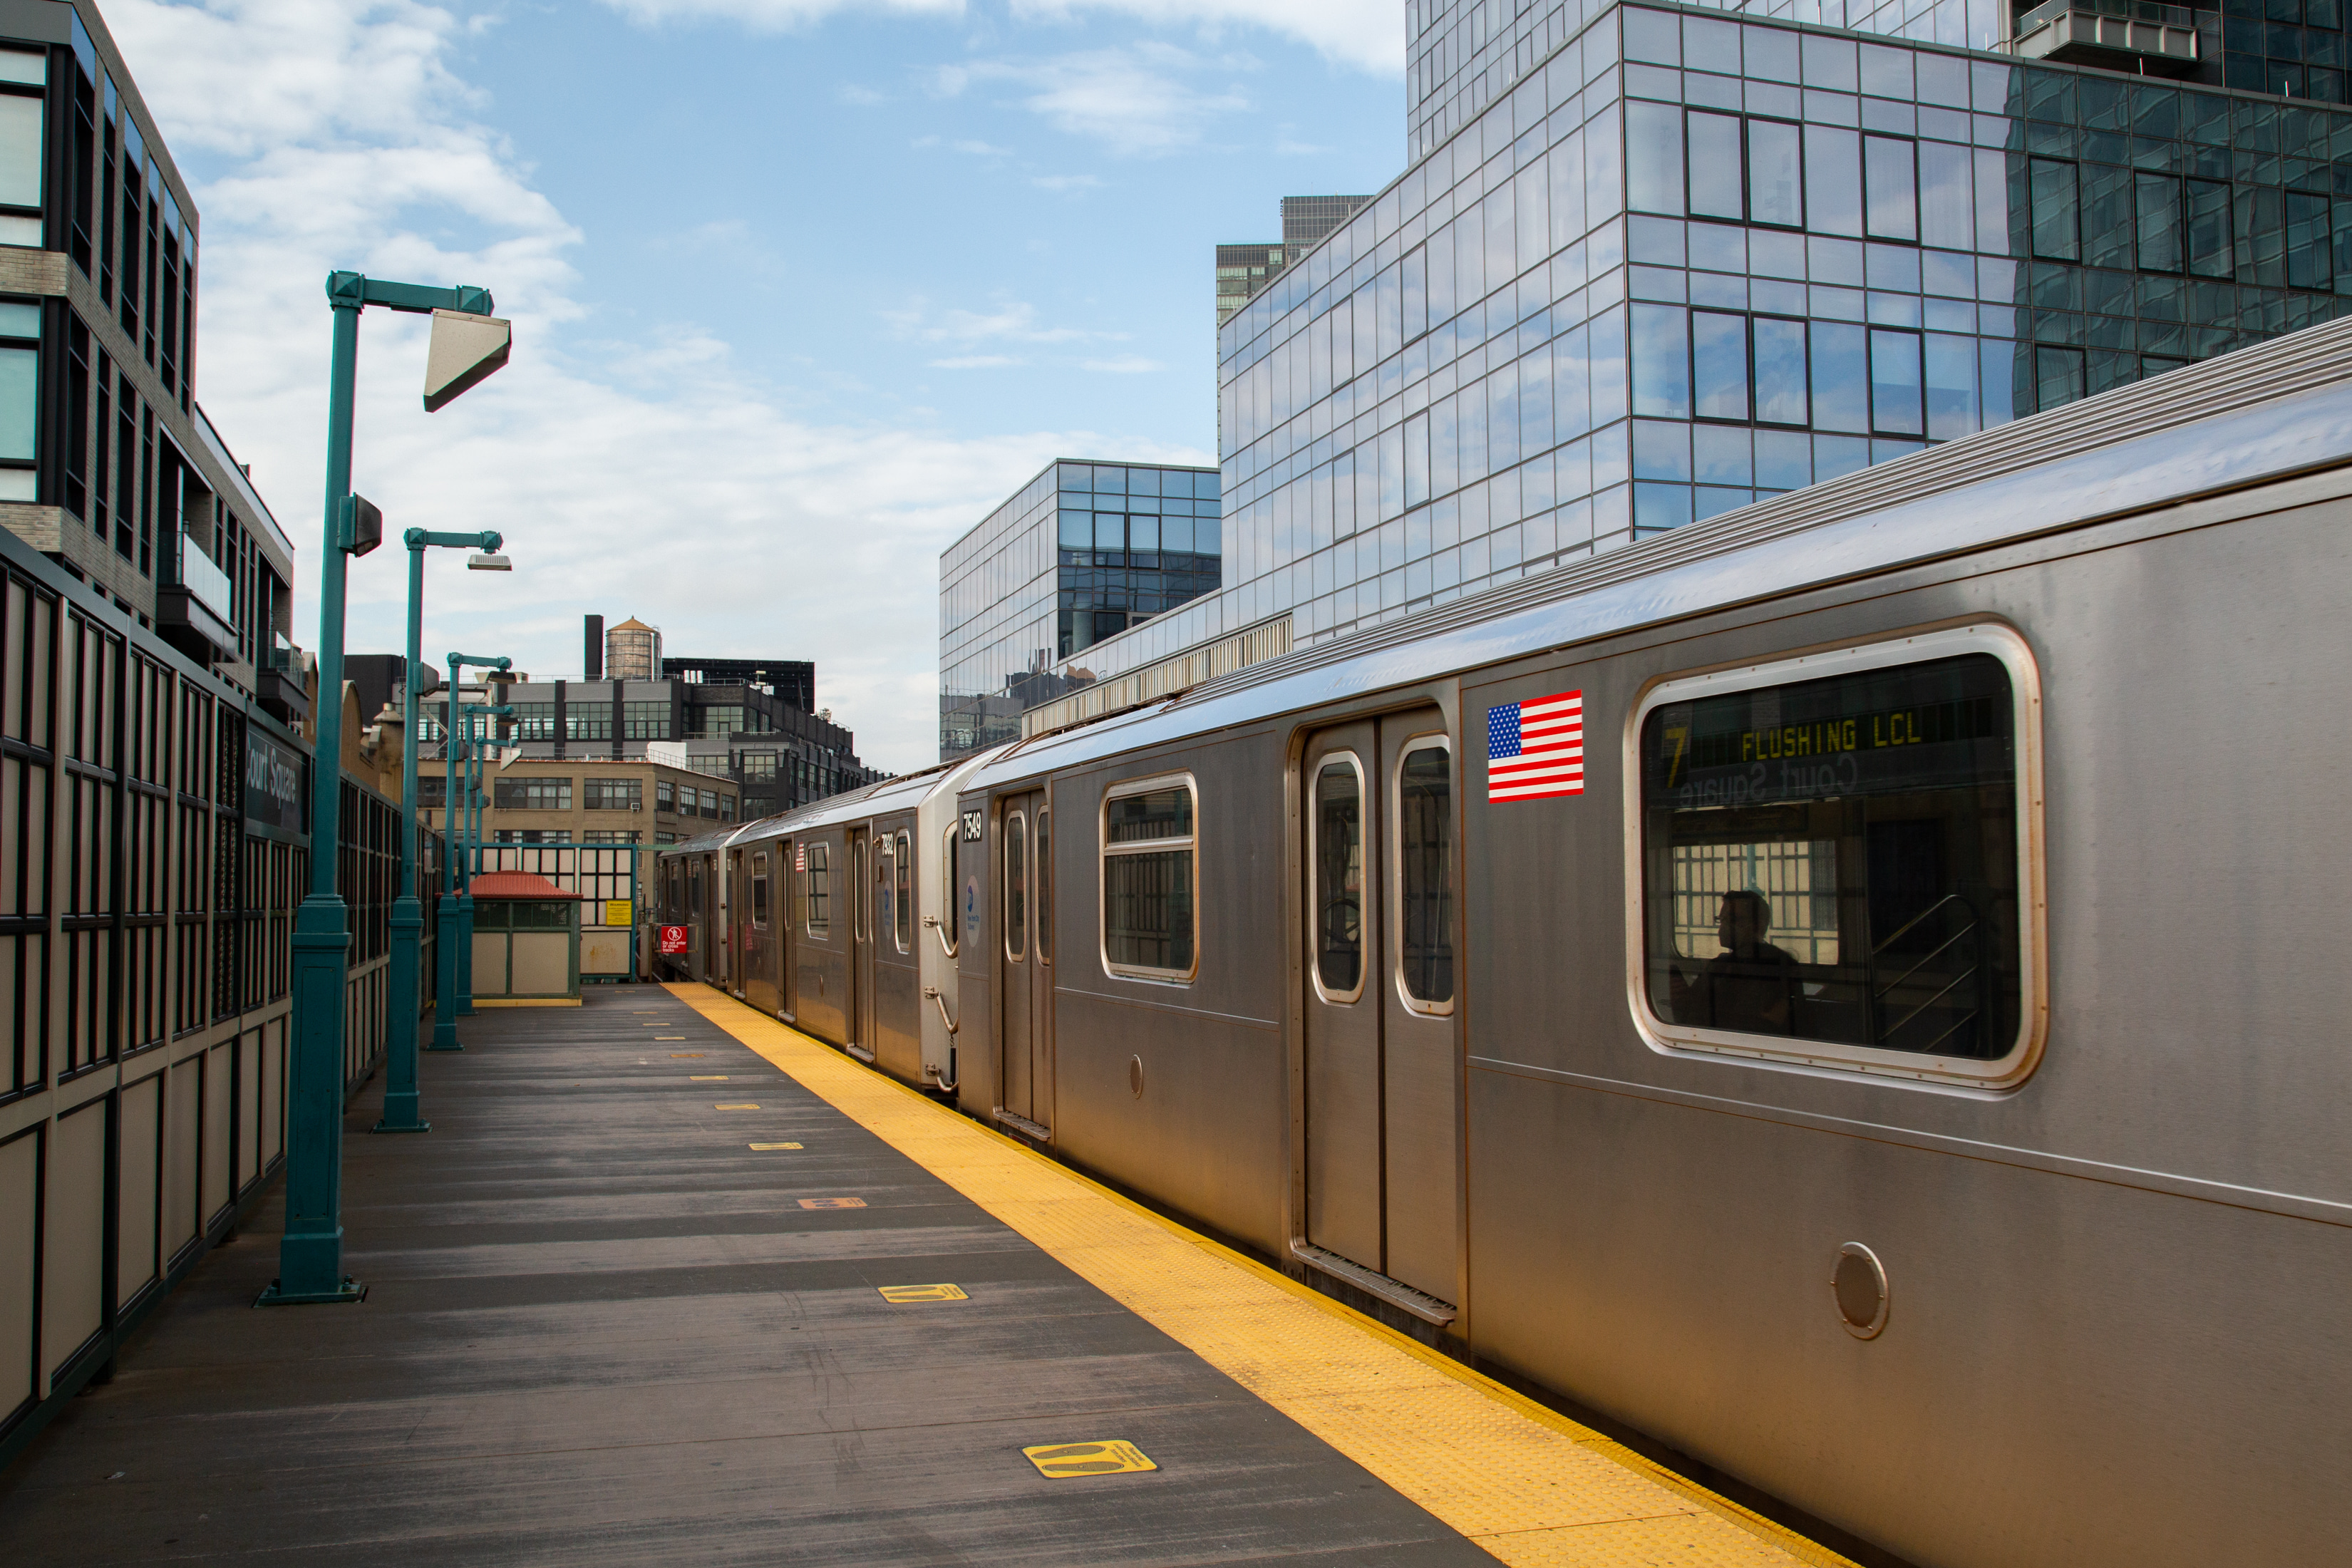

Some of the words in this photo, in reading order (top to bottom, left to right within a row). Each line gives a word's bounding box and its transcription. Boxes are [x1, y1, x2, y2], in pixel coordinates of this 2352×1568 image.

[1664, 726, 1688, 788] 7
[1742, 719, 1855, 762] FLUSHING
[1873, 712, 1922, 748] LCL
[270, 747, 296, 810] Square
[881, 832, 894, 855] 7932
[964, 812, 981, 840] 7549
